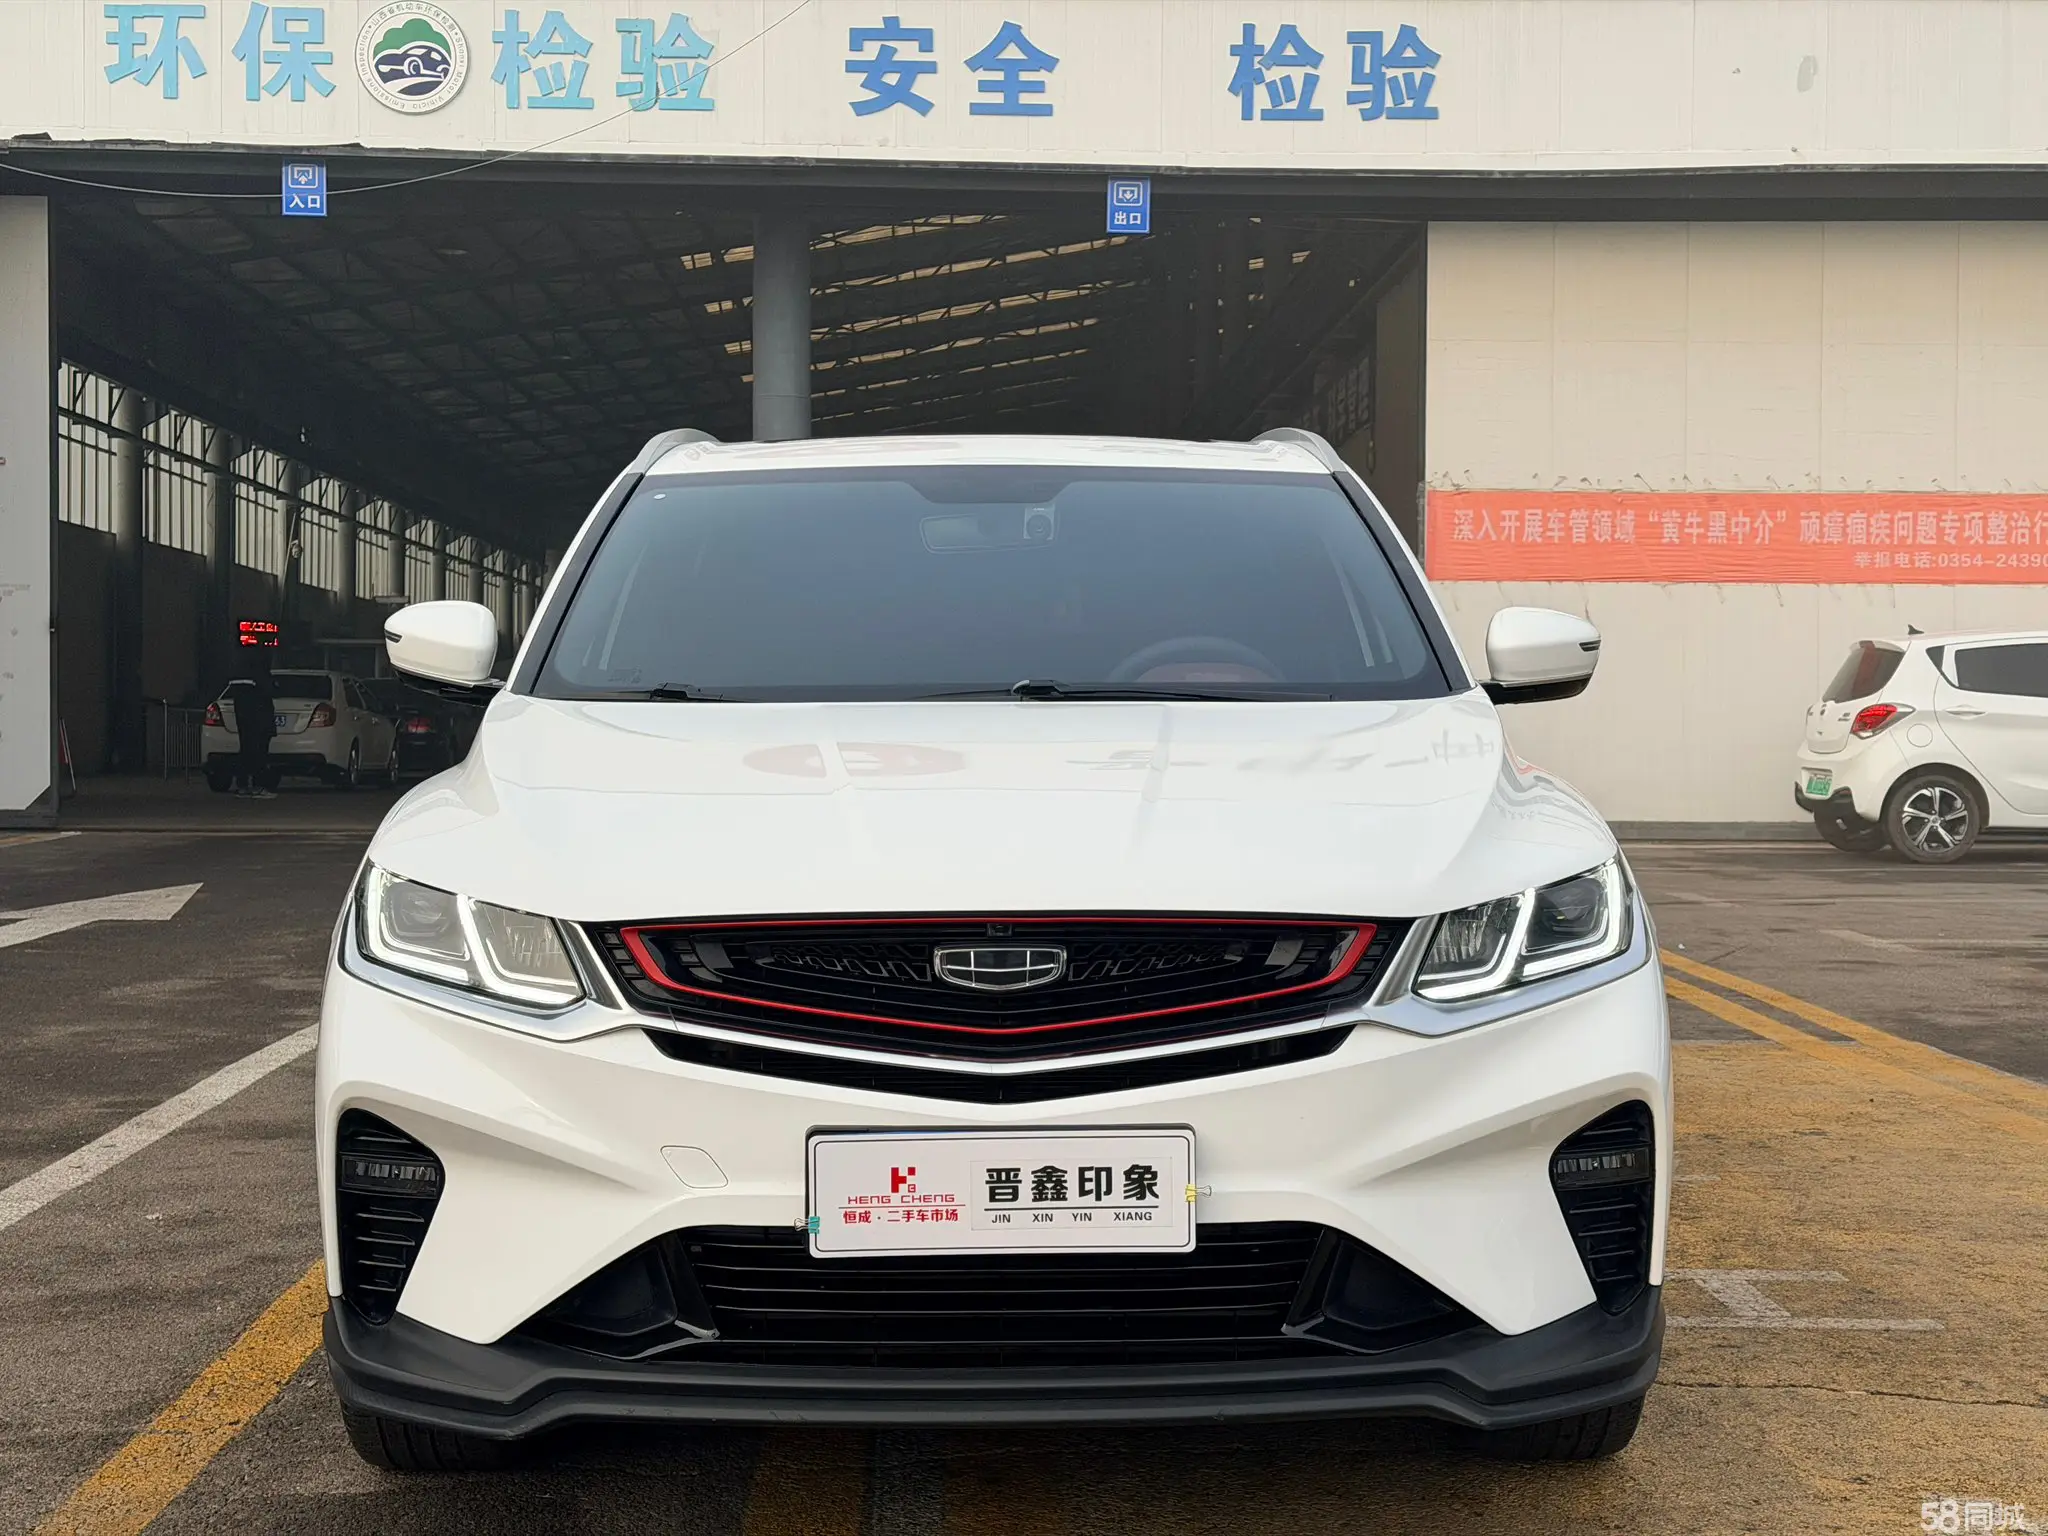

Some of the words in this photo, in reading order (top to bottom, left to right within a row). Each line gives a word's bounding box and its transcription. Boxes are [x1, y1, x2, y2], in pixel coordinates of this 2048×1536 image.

[104, 2, 336, 101] 环保
[491, 9, 714, 112] 检验
[845, 16, 1060, 117] 安全
[1227, 23, 1441, 122] 检验
[289, 193, 320, 209] 入口
[1114, 211, 1141, 225] 出口
[985, 1164, 1159, 1203] 晋鑫印象
[848, 1195, 892, 1205] HENG
[900, 1194, 955, 1204] CHENG
[991, 1214, 1011, 1224] JIN
[1032, 1213, 1054, 1223] XIN
[1071, 1212, 1092, 1222] YIN
[1113, 1211, 1153, 1222] XIANG
